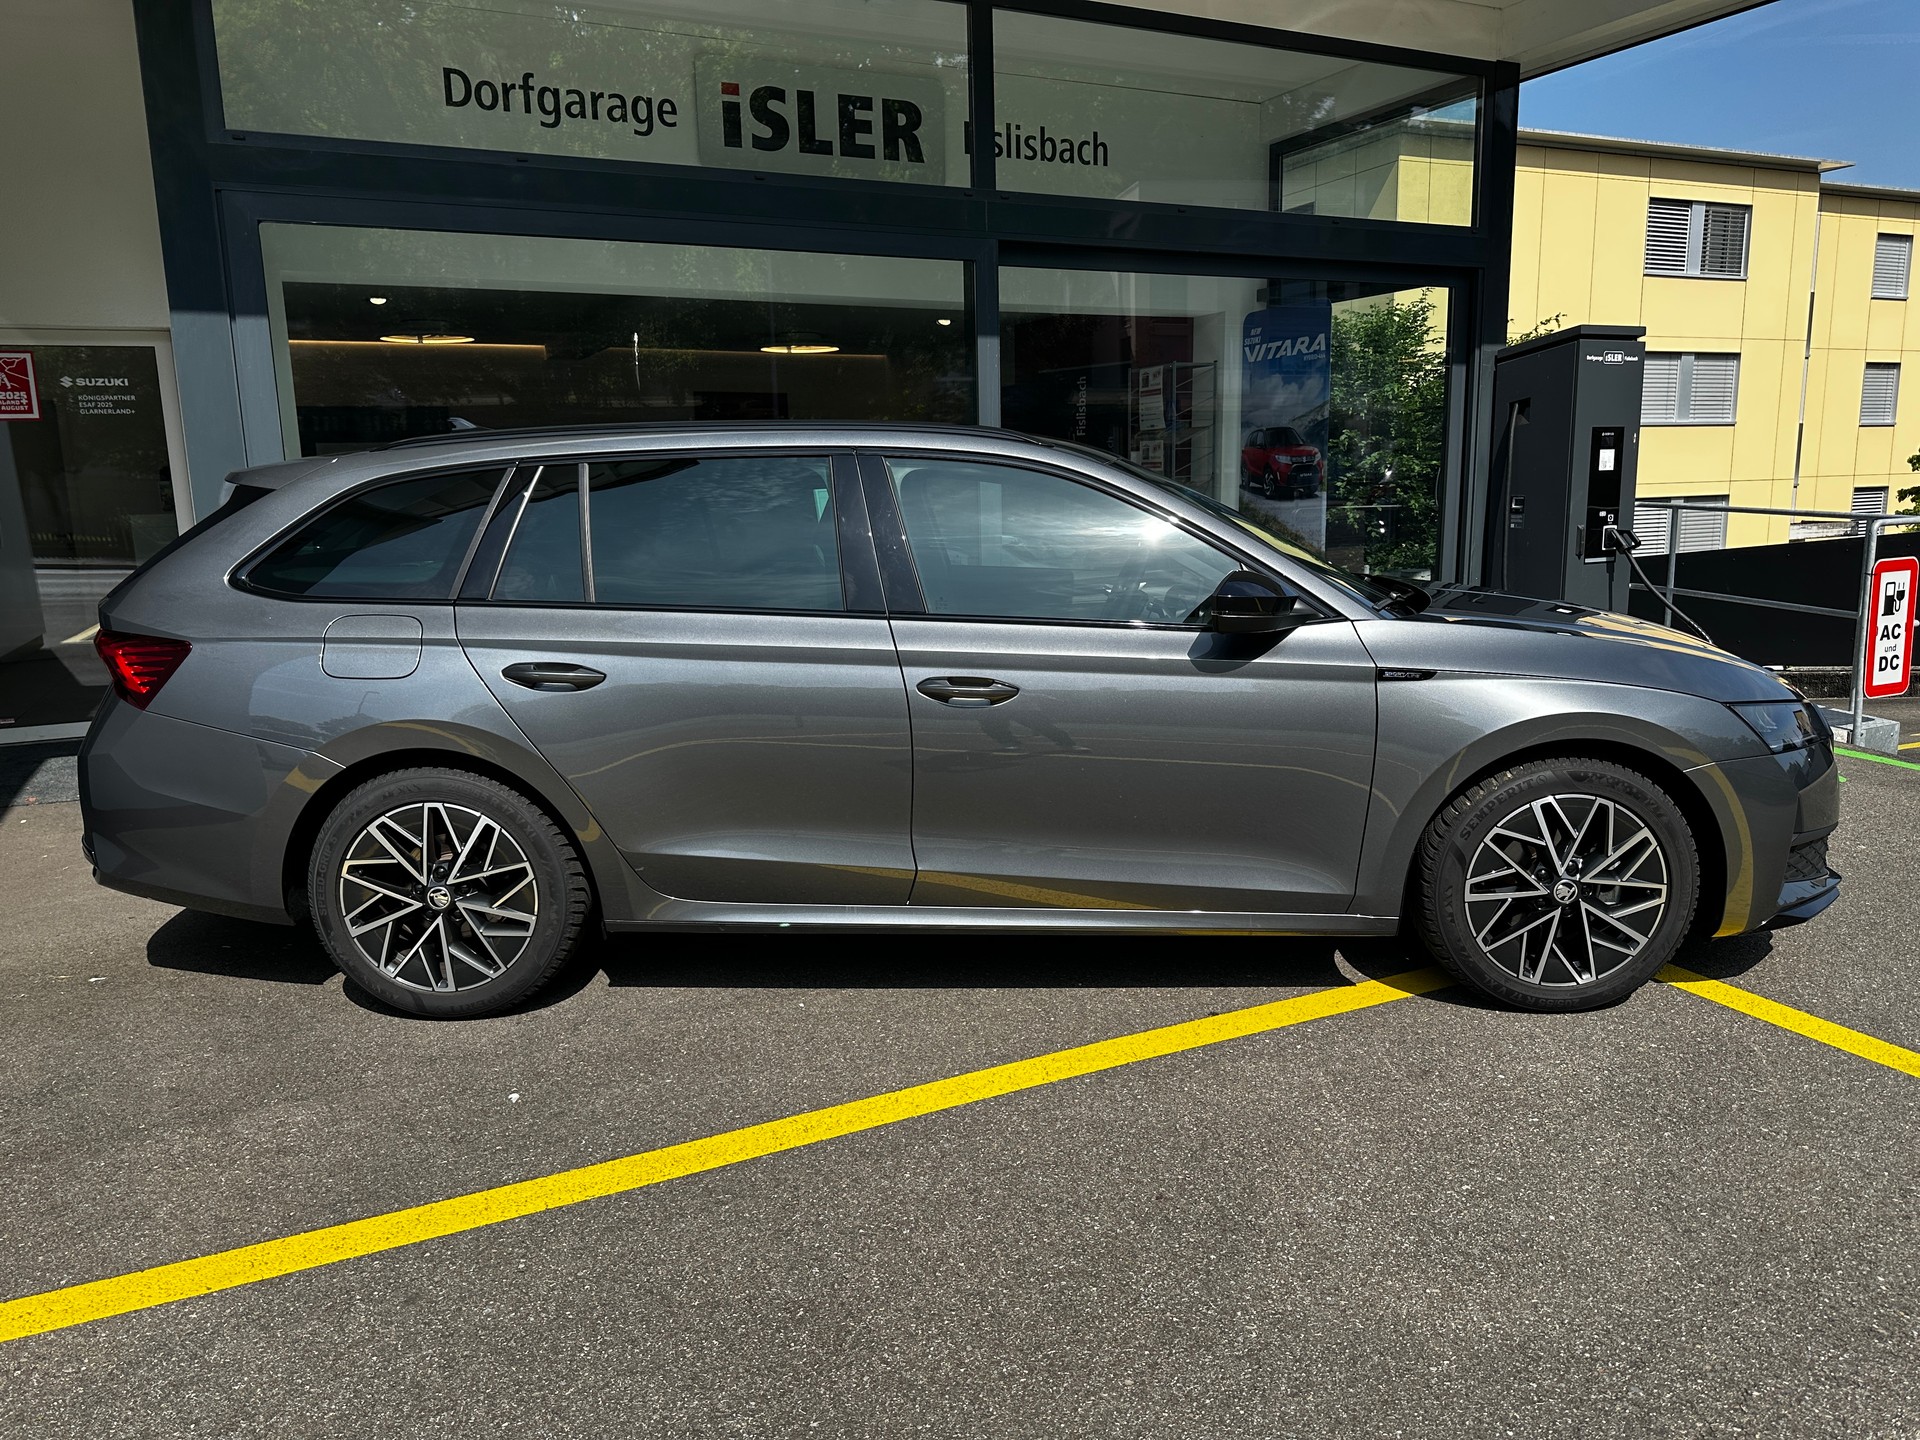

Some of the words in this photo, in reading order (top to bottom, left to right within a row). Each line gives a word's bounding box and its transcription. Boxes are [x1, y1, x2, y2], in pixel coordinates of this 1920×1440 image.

[443, 67, 678, 137] Dorfgarage
[721, 82, 925, 164] iSLER
[964, 120, 1109, 166] slisbach
[1244, 333, 1327, 363] VITARA
[75, 377, 129, 387] SUZUKI
[0, 391, 28, 400] 2025
[78, 393, 137, 401] KÖNIGSPARTNER
[1076, 376, 1087, 436] Fislisbach
[1880, 623, 1902, 641] AC
[1884, 643, 1897, 653] und
[1878, 654, 1900, 672] DC
[1460, 781, 1534, 841] SEMPERIT
[319, 846, 334, 915] SPEED-GRIP
